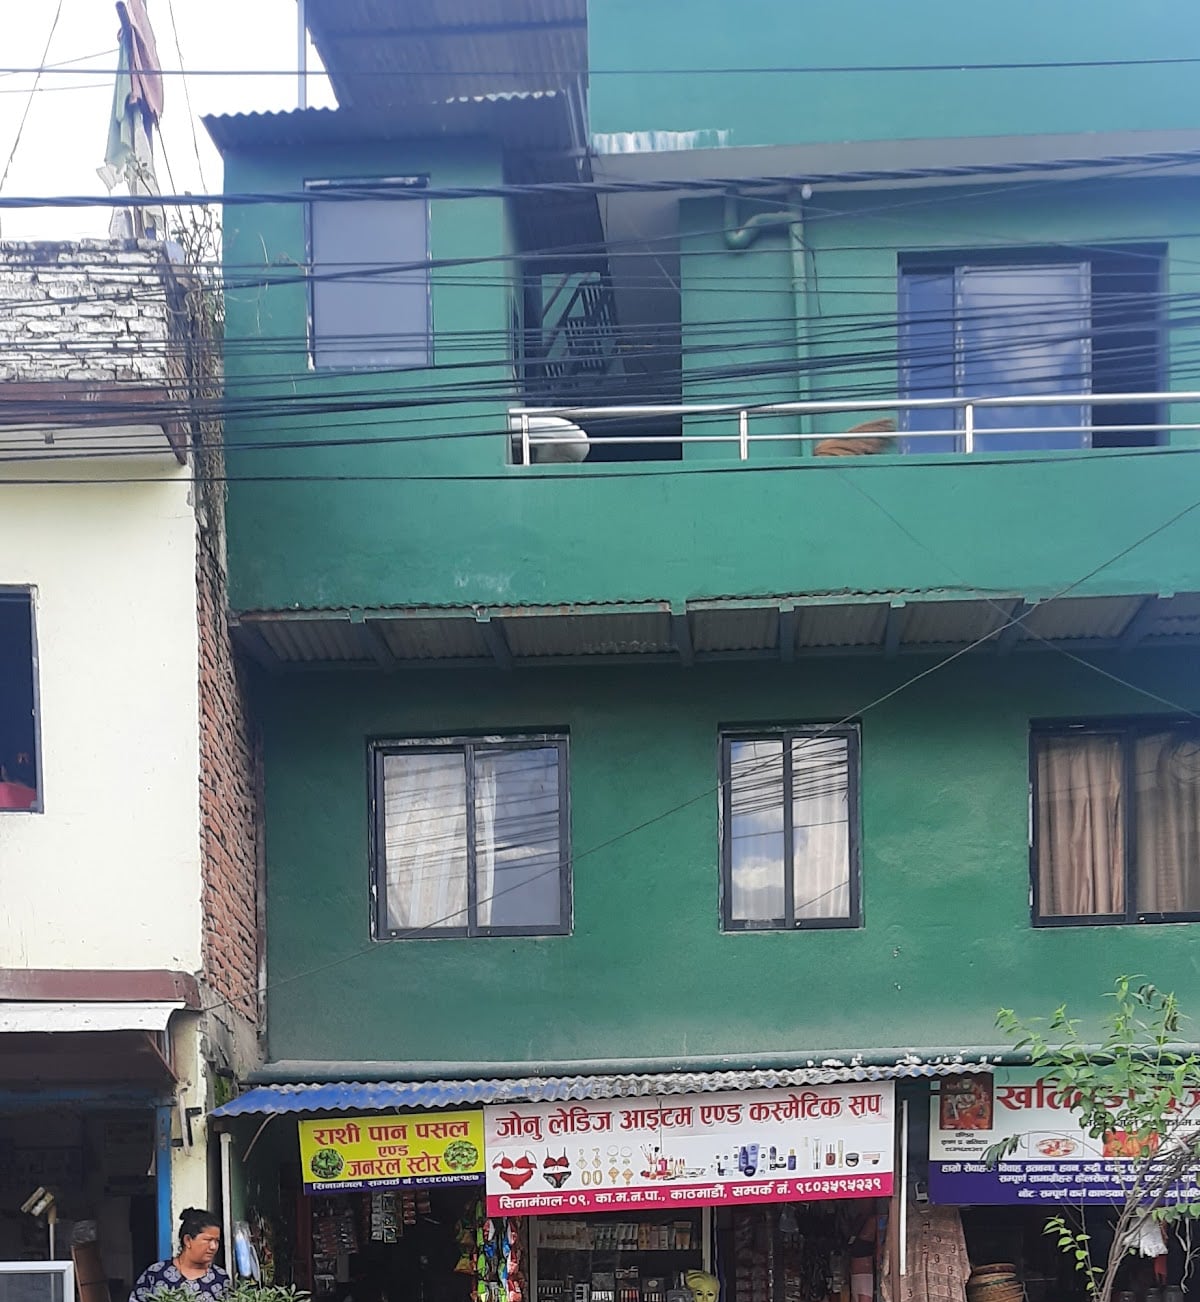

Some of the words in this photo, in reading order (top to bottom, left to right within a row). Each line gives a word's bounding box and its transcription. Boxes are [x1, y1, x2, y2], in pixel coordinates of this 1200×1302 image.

[496, 1111, 542, 1140] जोनु
[548, 1106, 612, 1134] लेडिज
[619, 1106, 693, 1131] आइटम
[700, 1104, 742, 1125] एण्ड
[749, 1092, 842, 1122] कस्मेटिक
[848, 1094, 882, 1116] सप
[313, 1122, 361, 1146] राशी
[368, 1125, 408, 1141] पान
[415, 1121, 470, 1138] पसल
[378, 1145, 409, 1157] एण्ड
[347, 1157, 401, 1177] जनरल
[406, 1151, 442, 1175] स्टोर
[732, 1181, 775, 1197] सम्पर्क
[776, 1180, 791, 1195] नं.
